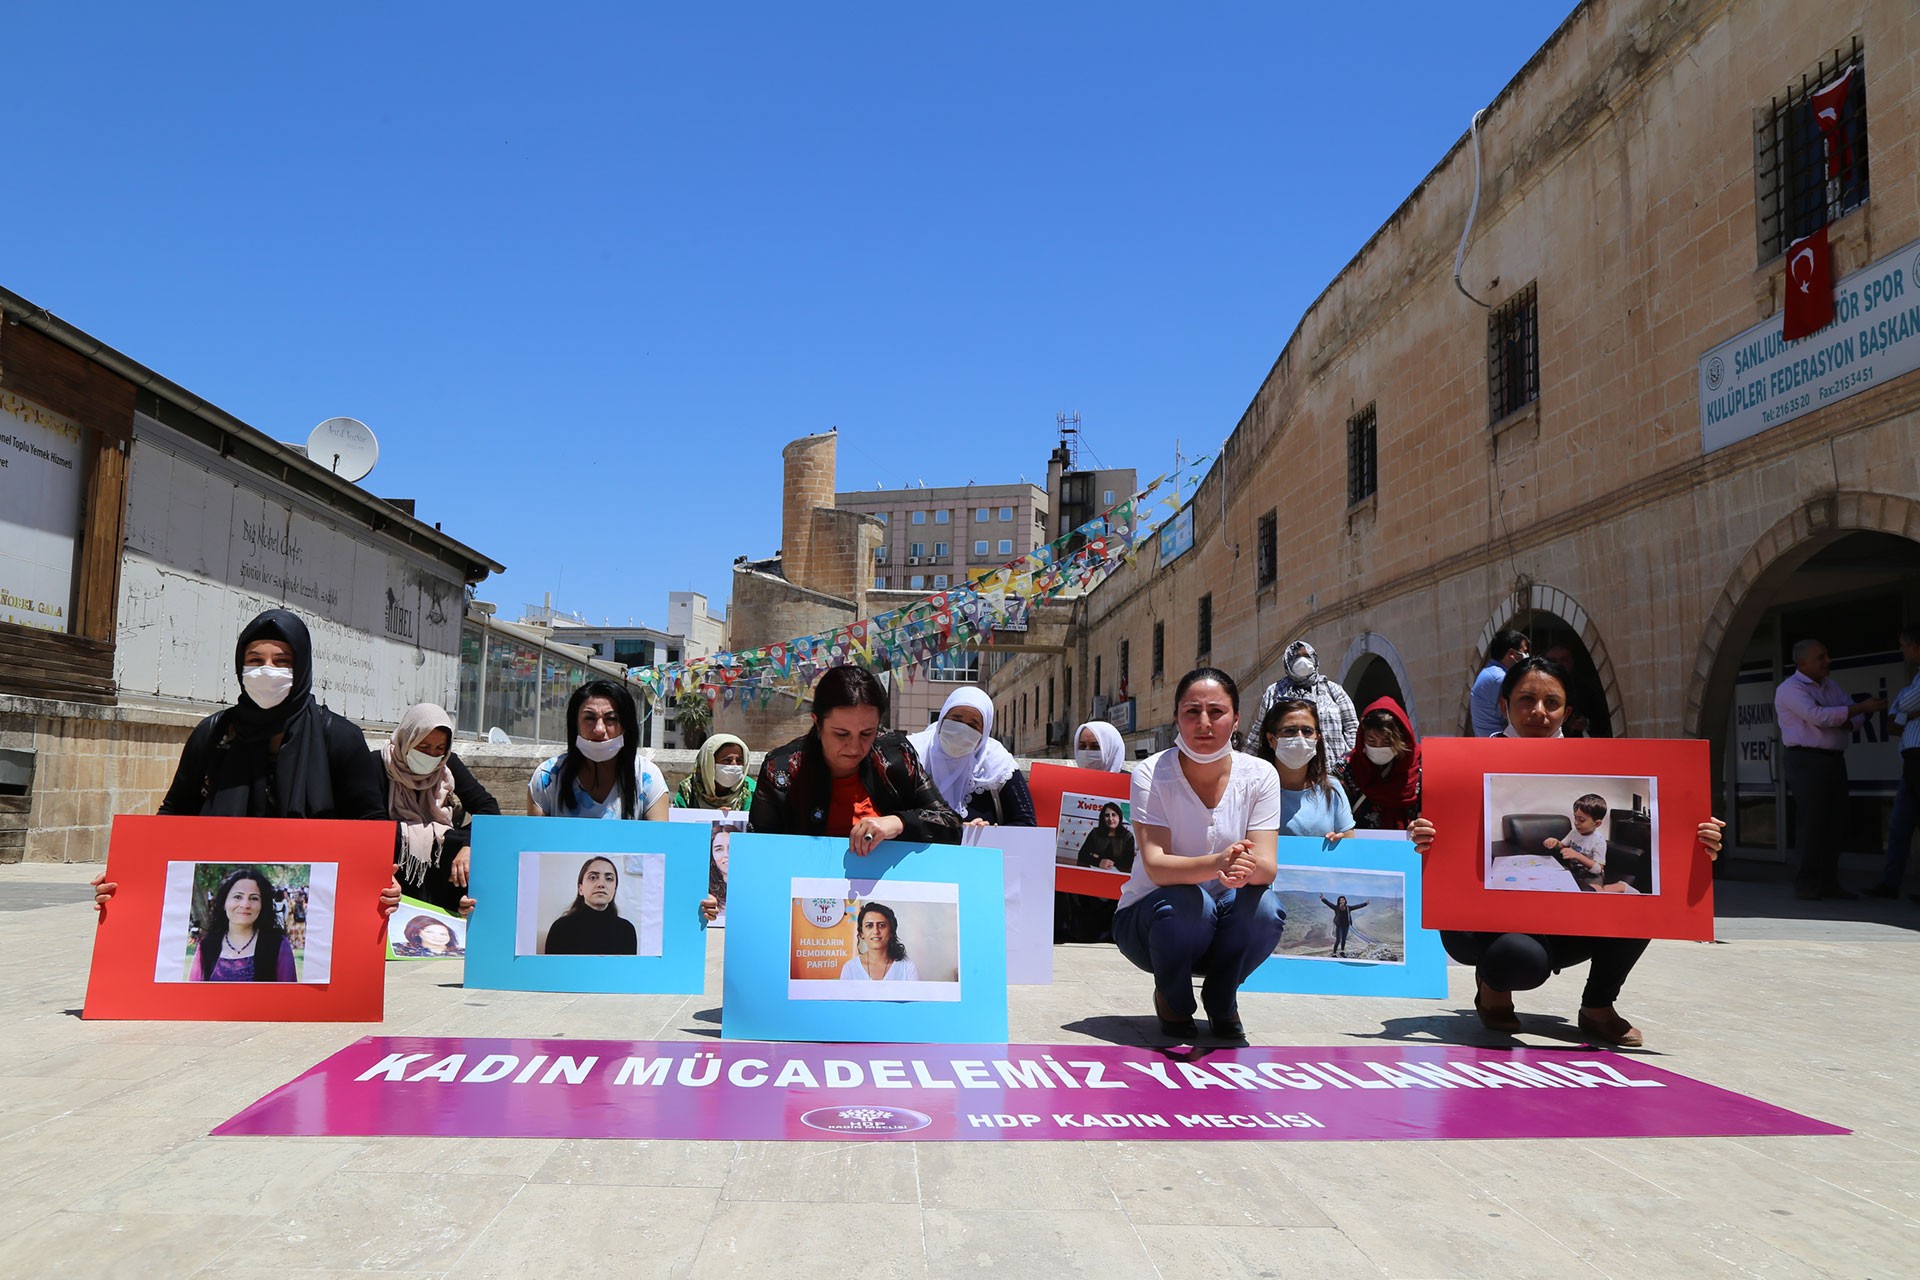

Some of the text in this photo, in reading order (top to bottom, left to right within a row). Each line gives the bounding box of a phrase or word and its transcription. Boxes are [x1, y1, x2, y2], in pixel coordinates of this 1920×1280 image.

[1735, 328, 1799, 380] ŞANLIUR
[1864, 269, 1904, 312] SPOR
[1771, 336, 1855, 397] FEDERASYON
[12, 436, 30, 452] Toplu
[30, 443, 51, 461] Yemek
[50, 452, 73, 470] Hizmeti
[0, 593, 63, 617] NOBEL GALA
[387, 603, 412, 638] NOBEL
[816, 915, 832, 923] HDP
[796, 947, 848, 957] DEMOKRATİK
[800, 938, 845, 946] HALKLARIN
[806, 958, 838, 969] PARTİSİ
[353, 1053, 1669, 1090] KADIN MÜCADELEMİZ YARGILANAMAZ
[966, 1112, 1326, 1129] HDP KADIN MECLİSİ
